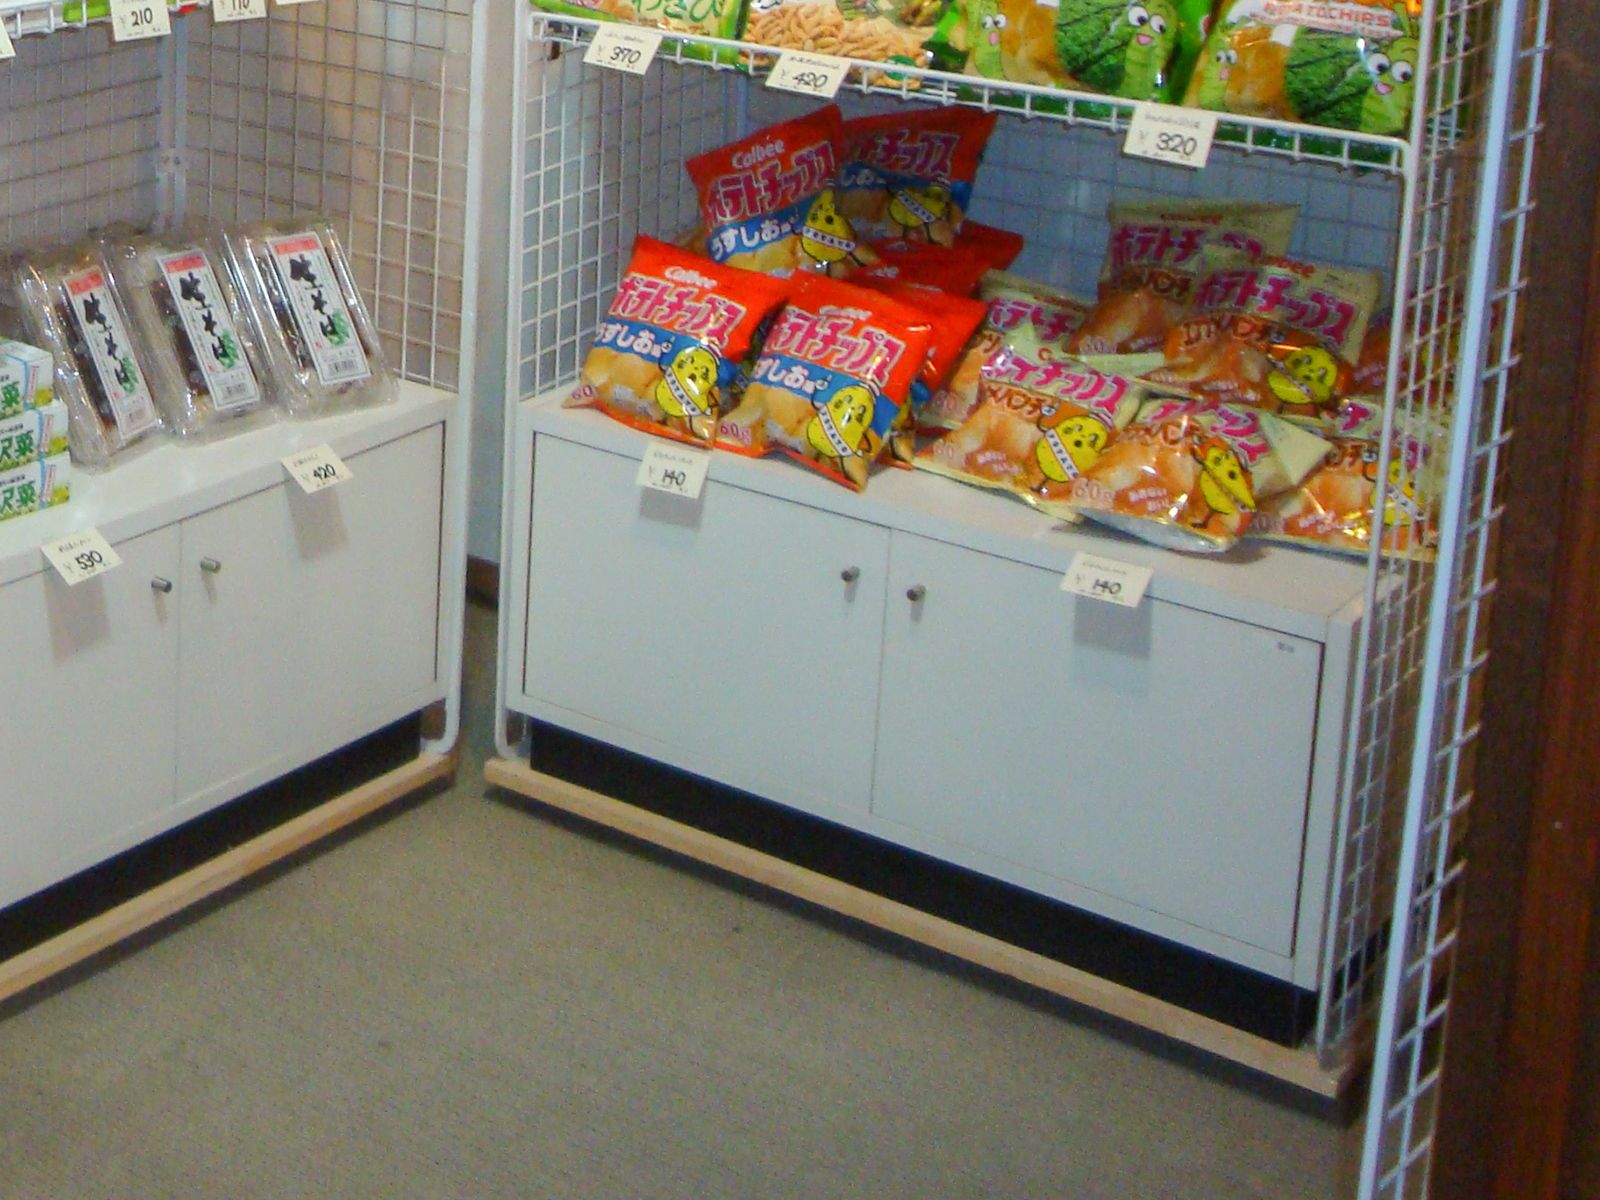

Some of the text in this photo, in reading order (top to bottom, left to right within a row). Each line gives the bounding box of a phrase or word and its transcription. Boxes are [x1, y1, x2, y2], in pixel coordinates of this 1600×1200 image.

[131, 7, 153, 27] 210
[609, 45, 642, 66] 370
[793, 71, 829, 90] 420
[731, 139, 786, 170] Calbee
[1155, 131, 1198, 157] 320
[607, 271, 748, 349] ポテトチップス
[75, 549, 103, 571] 530
